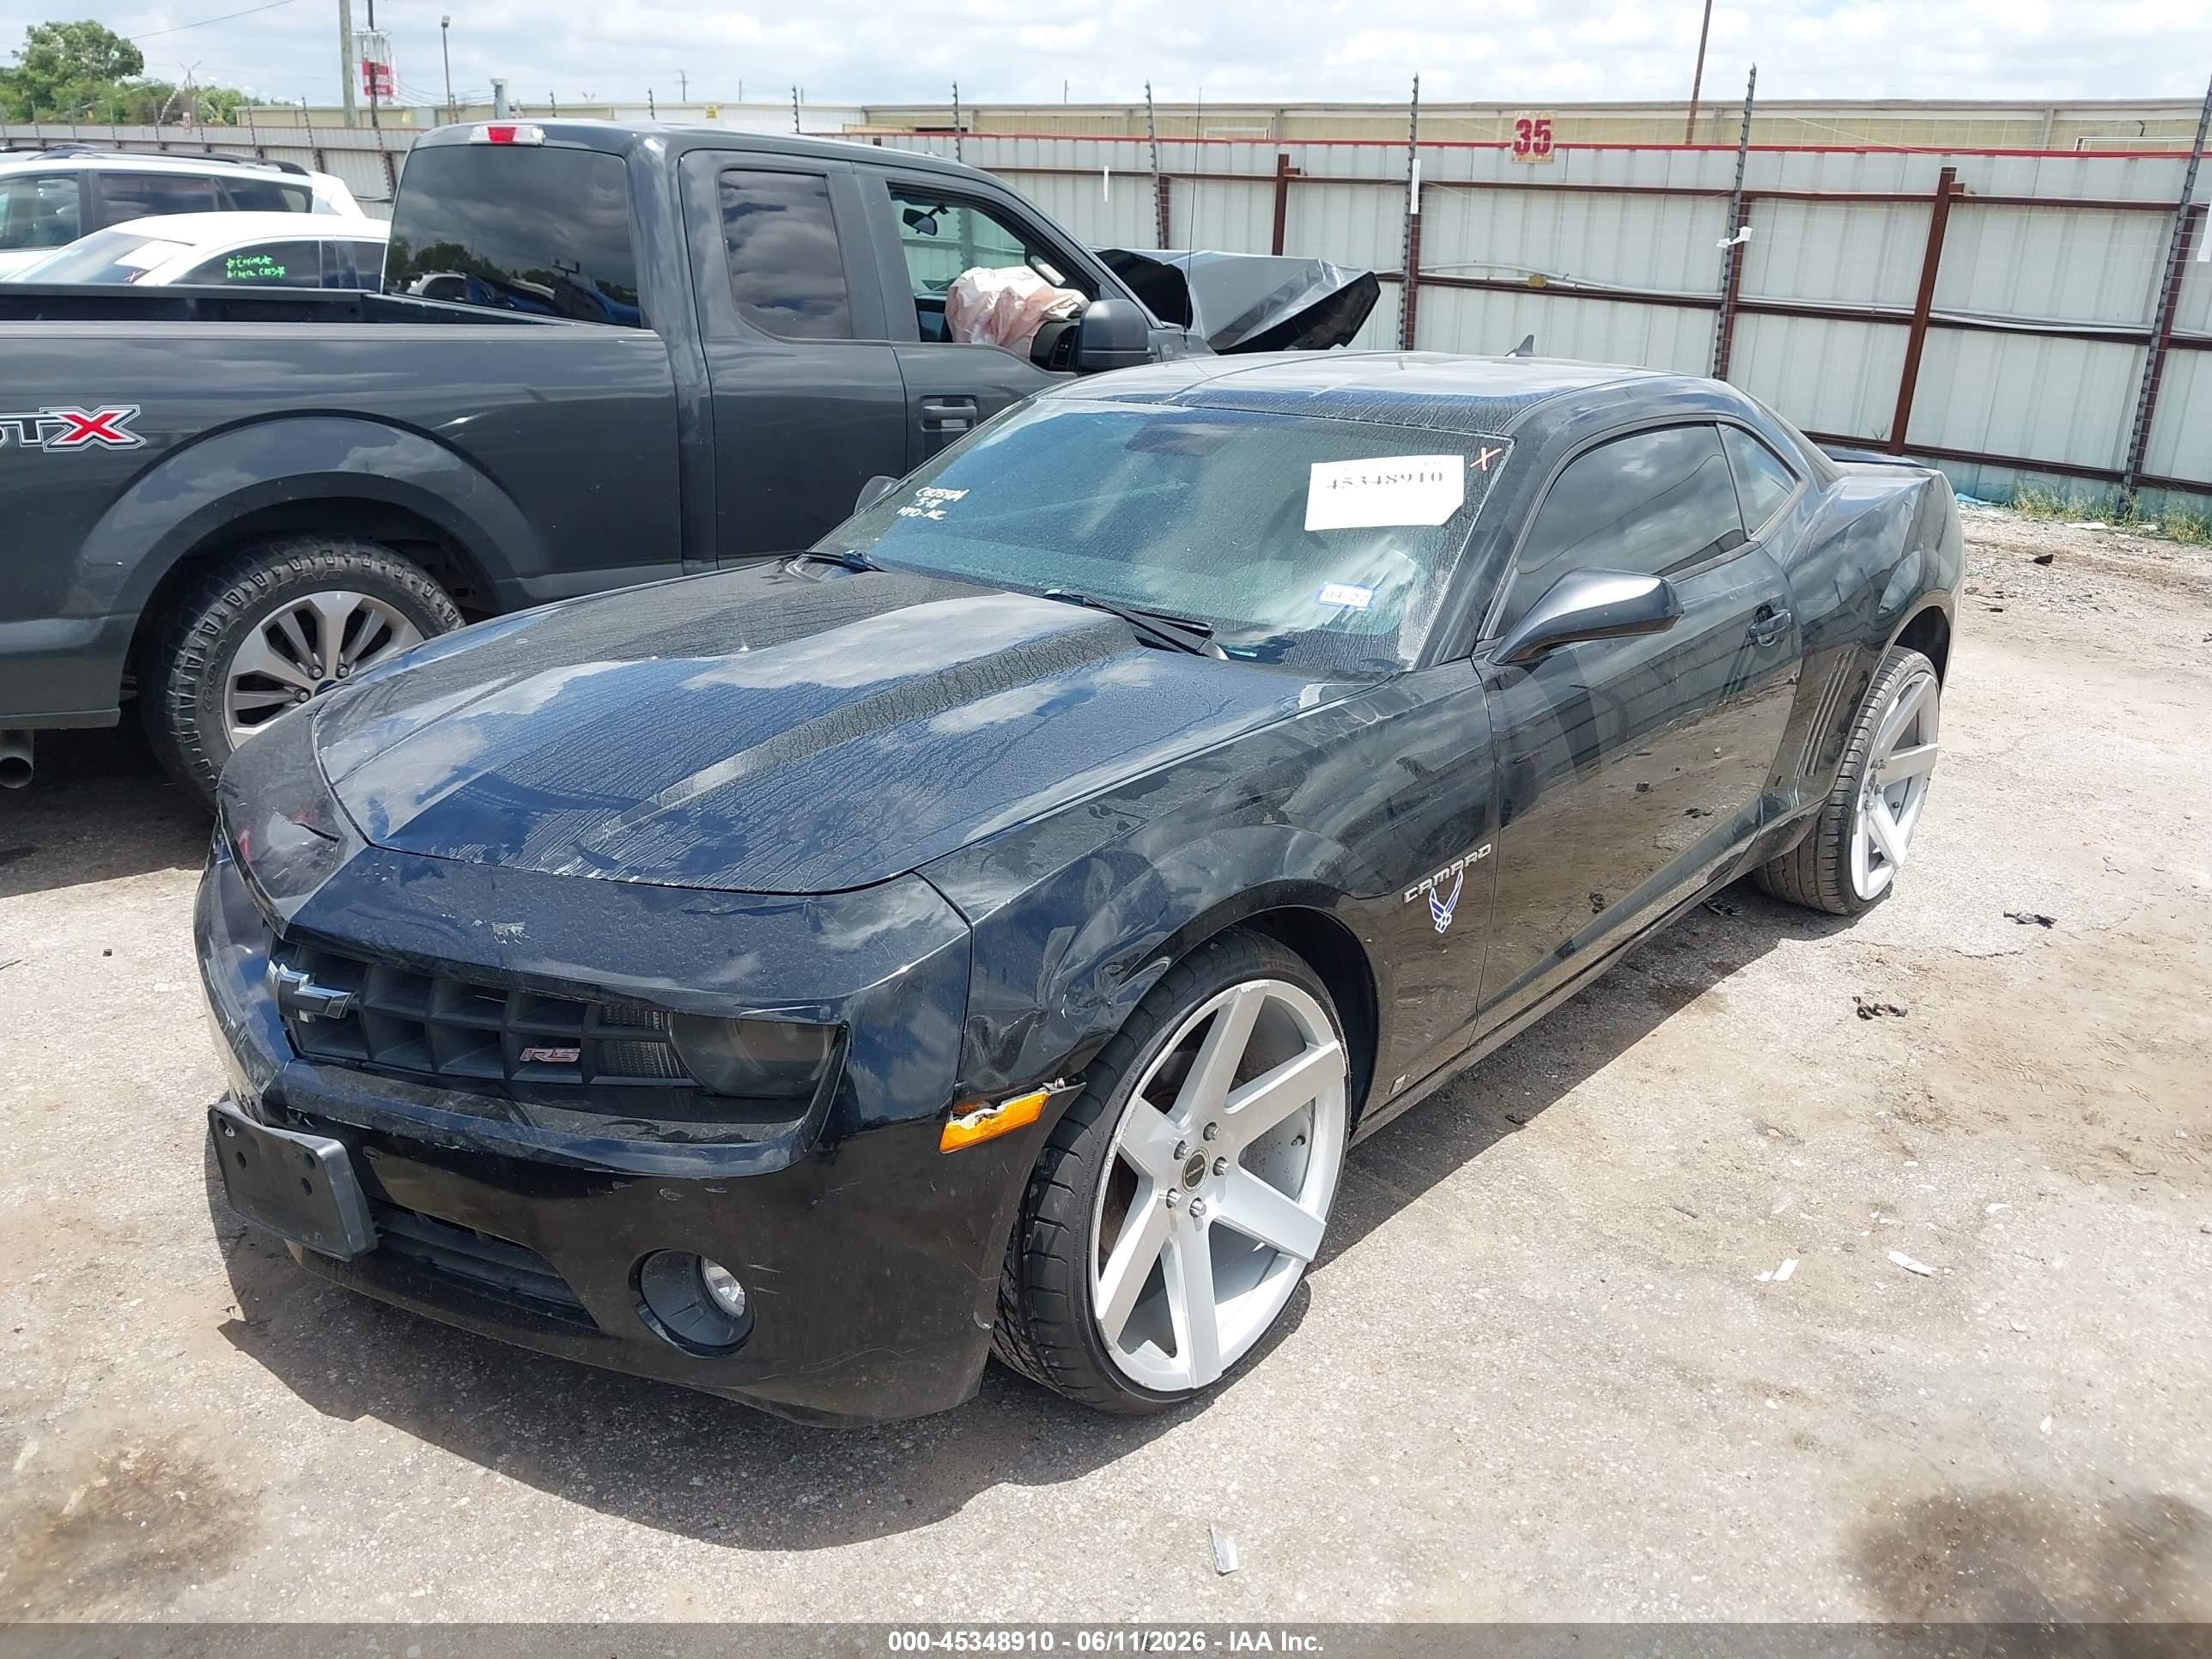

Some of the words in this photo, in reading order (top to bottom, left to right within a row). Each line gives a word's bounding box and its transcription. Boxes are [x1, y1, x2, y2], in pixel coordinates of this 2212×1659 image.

[1515, 118, 1551, 154] 35
[0, 404, 146, 453] TX
[1325, 471, 1443, 489] 45348910
[1403, 843, 1492, 903] CAMARO
[520, 1048, 580, 1061] RS
